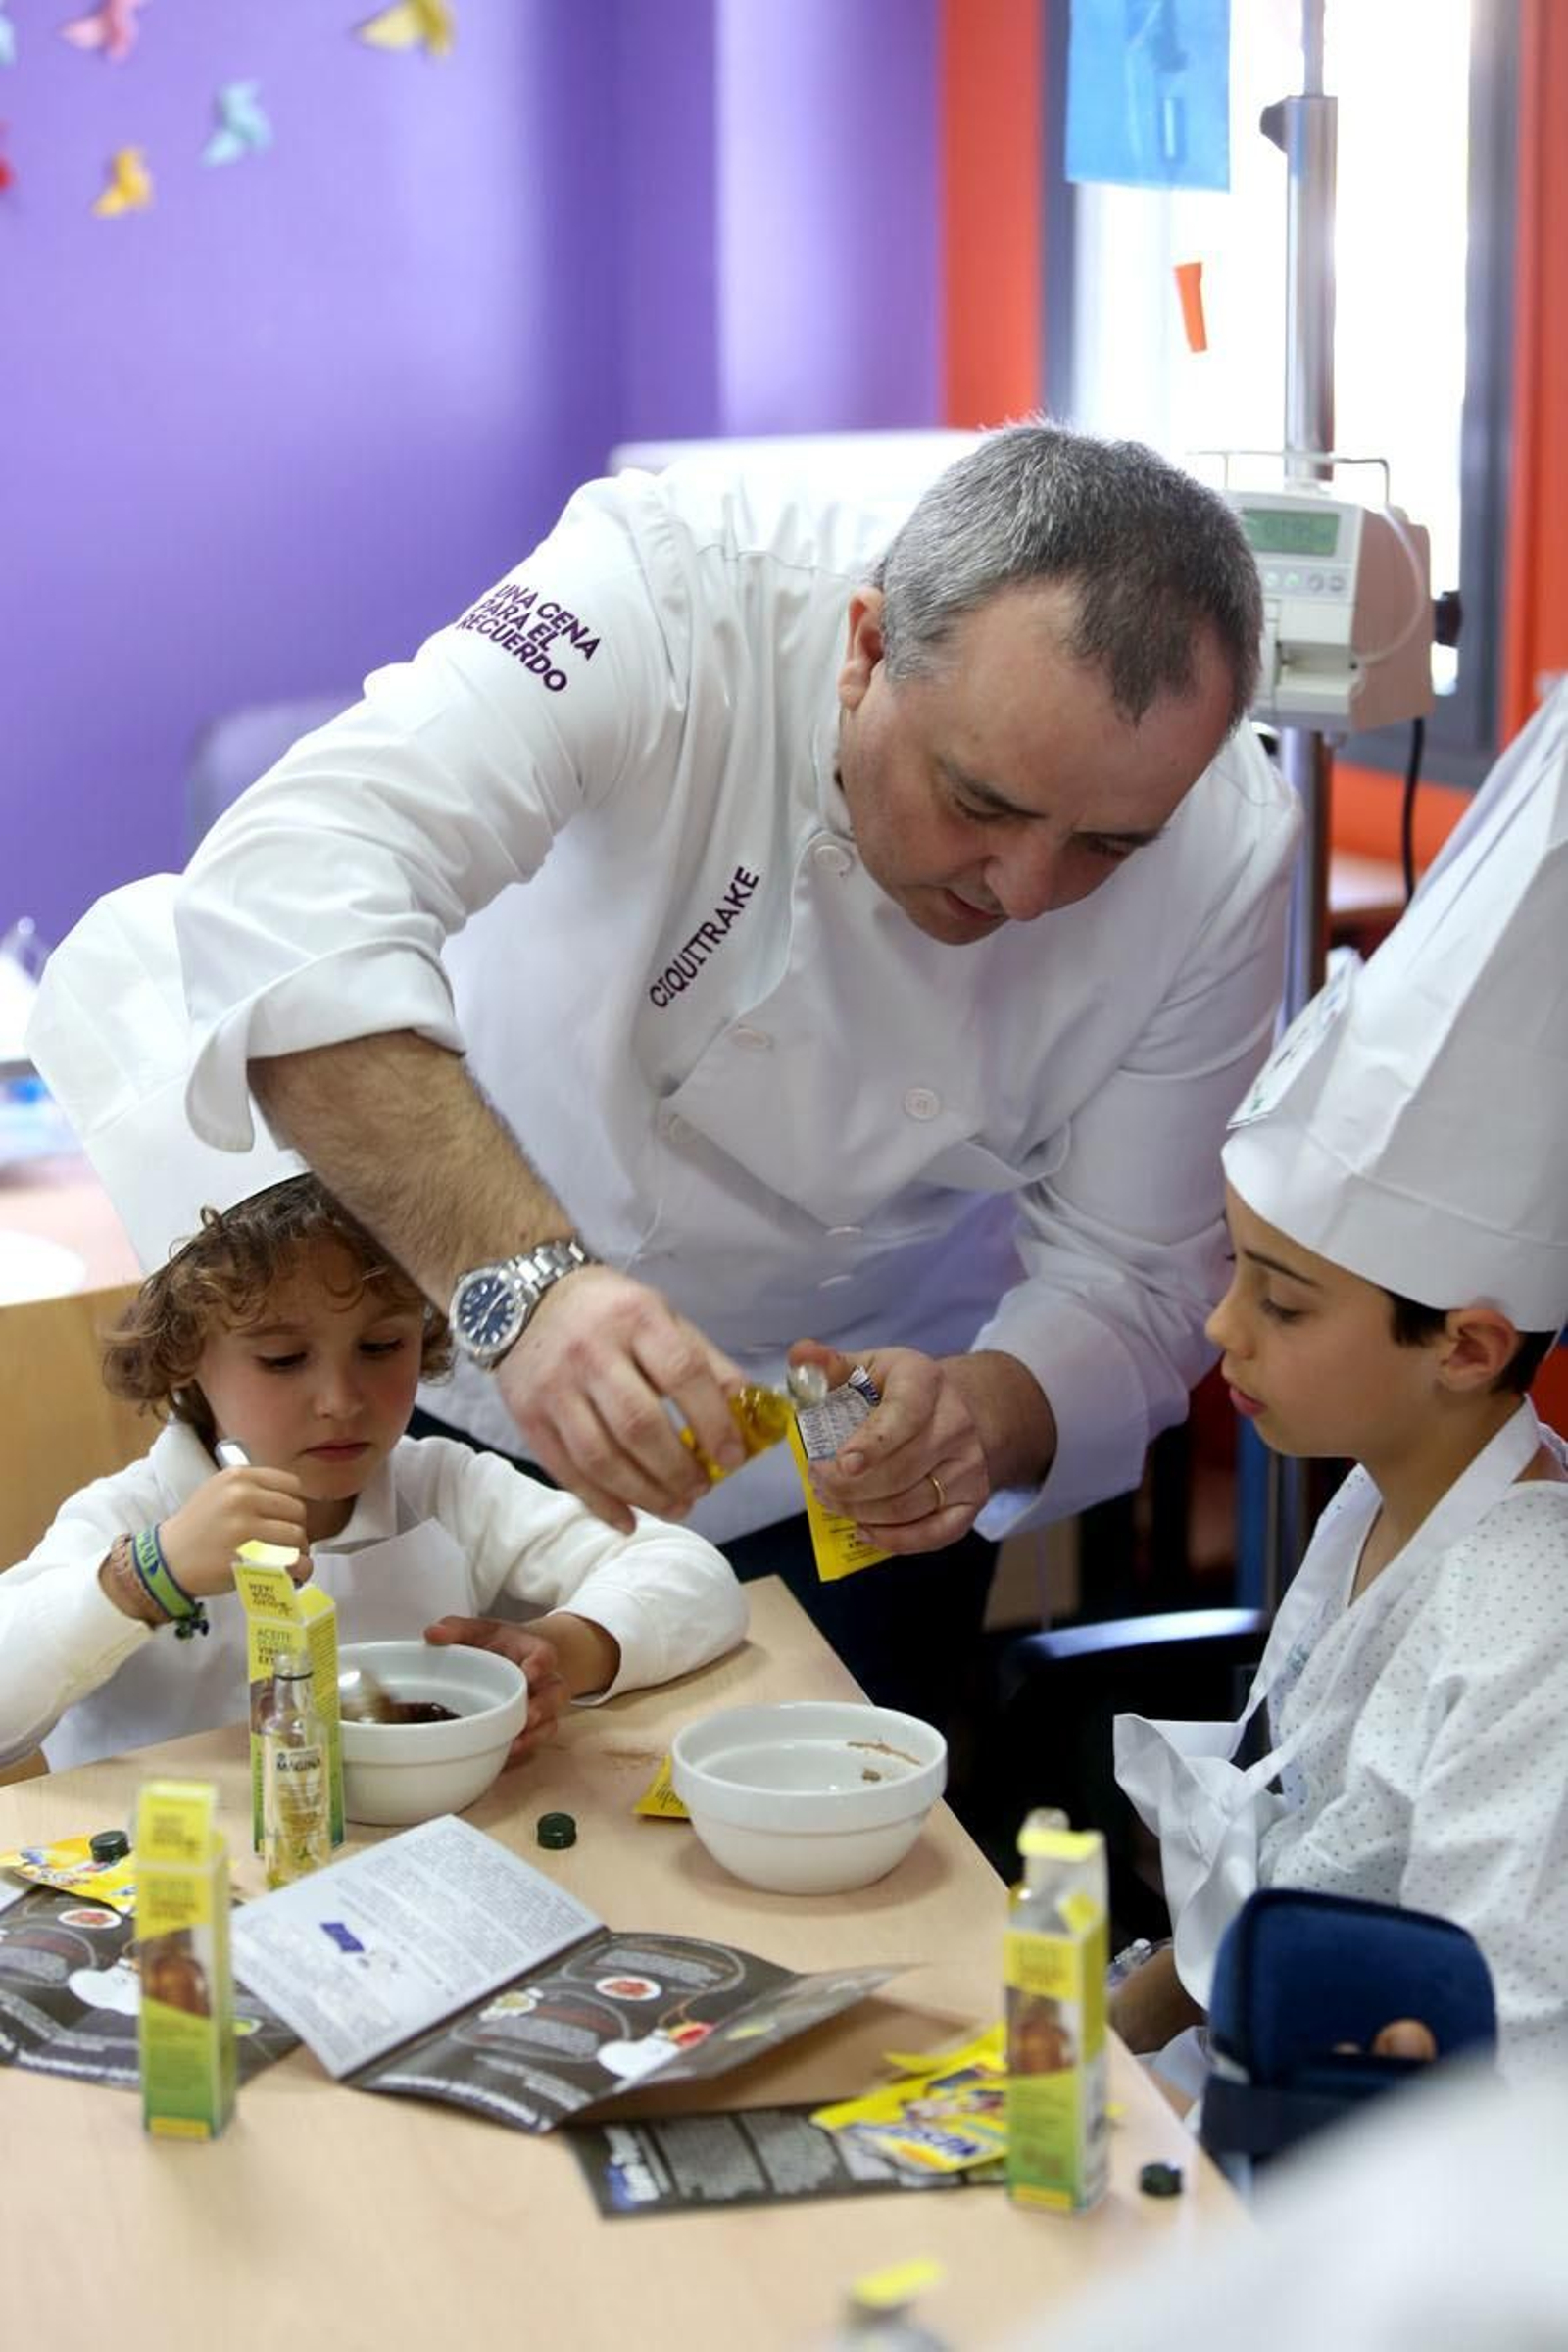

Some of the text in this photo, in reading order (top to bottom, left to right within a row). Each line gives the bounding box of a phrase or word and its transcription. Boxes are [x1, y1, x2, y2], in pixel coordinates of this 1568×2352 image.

[456, 613, 567, 692] RECUERDO
[473, 598, 559, 652] PARA EL
[494, 584, 601, 661] UNA CENA
[649, 865, 760, 1008] CIQUITRAKE
